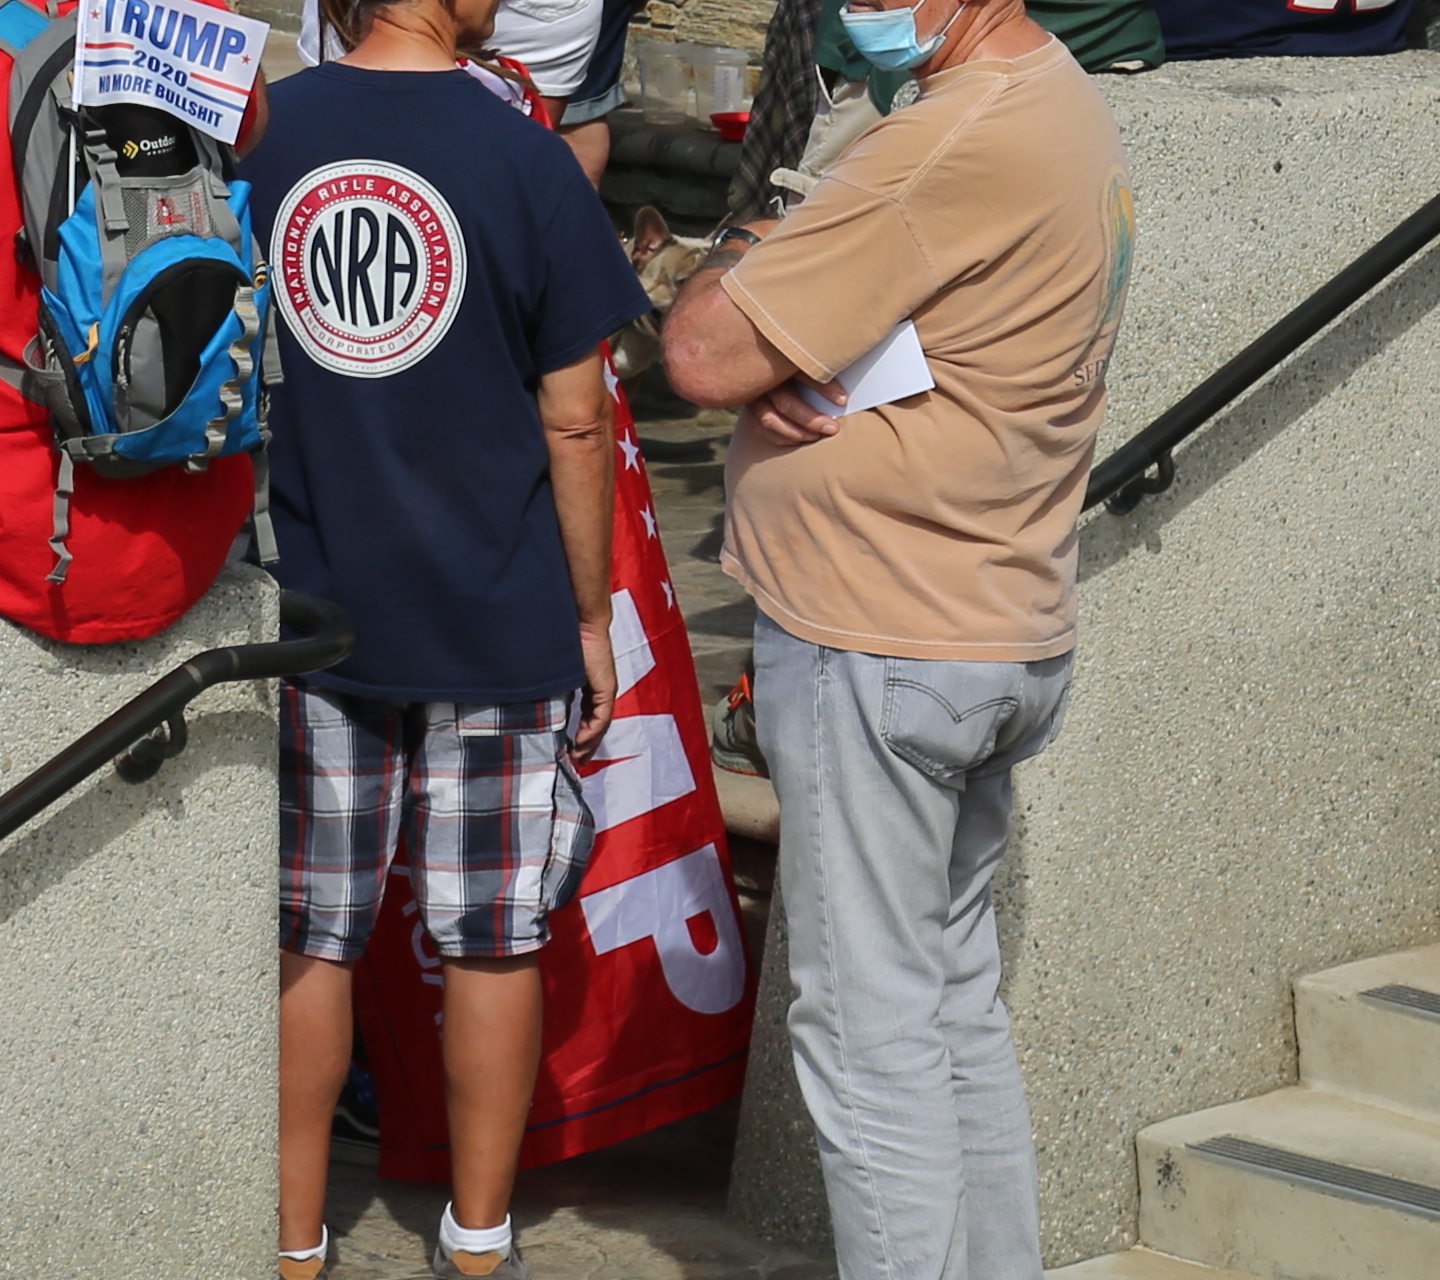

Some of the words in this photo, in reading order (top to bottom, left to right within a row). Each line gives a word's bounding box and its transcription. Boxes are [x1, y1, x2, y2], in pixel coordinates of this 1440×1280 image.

[131, 49, 189, 89] 2020
[98, 75, 110, 94] NO
[110, 74, 153, 95] MORE
[154, 84, 224, 128] BULLSHIT
[284, 204, 313, 305] NATIONAL
[319, 178, 375, 202] RIFLE
[386, 185, 448, 308] ASSOCIATION
[310, 206, 420, 329] NRA
[301, 310, 397, 357] INCORPORATED
